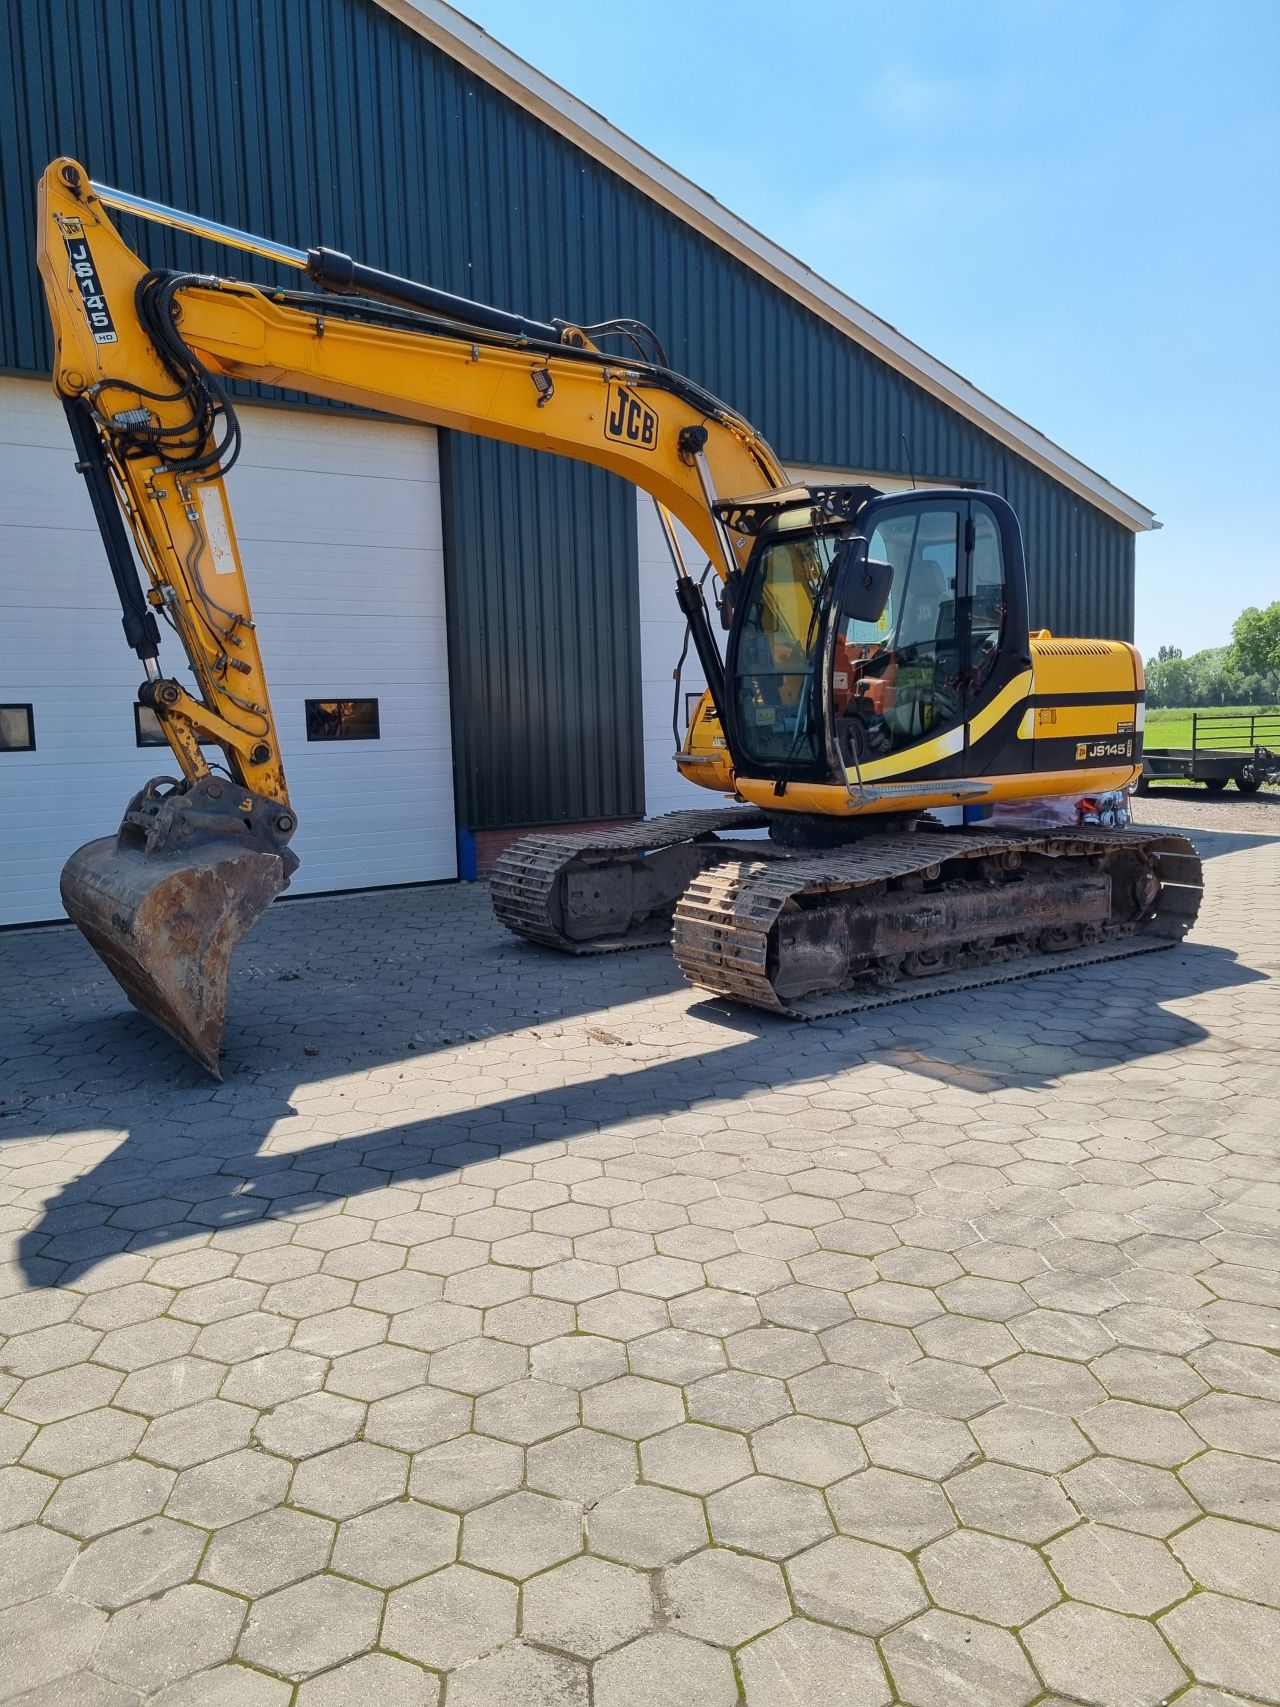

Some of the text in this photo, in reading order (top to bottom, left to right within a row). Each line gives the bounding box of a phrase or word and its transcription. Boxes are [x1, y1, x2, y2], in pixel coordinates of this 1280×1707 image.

[65, 223, 81, 235] JCB
[72, 245, 109, 327] JS145
[609, 386, 655, 444] JCB
[1089, 744, 1126, 757] JS145
